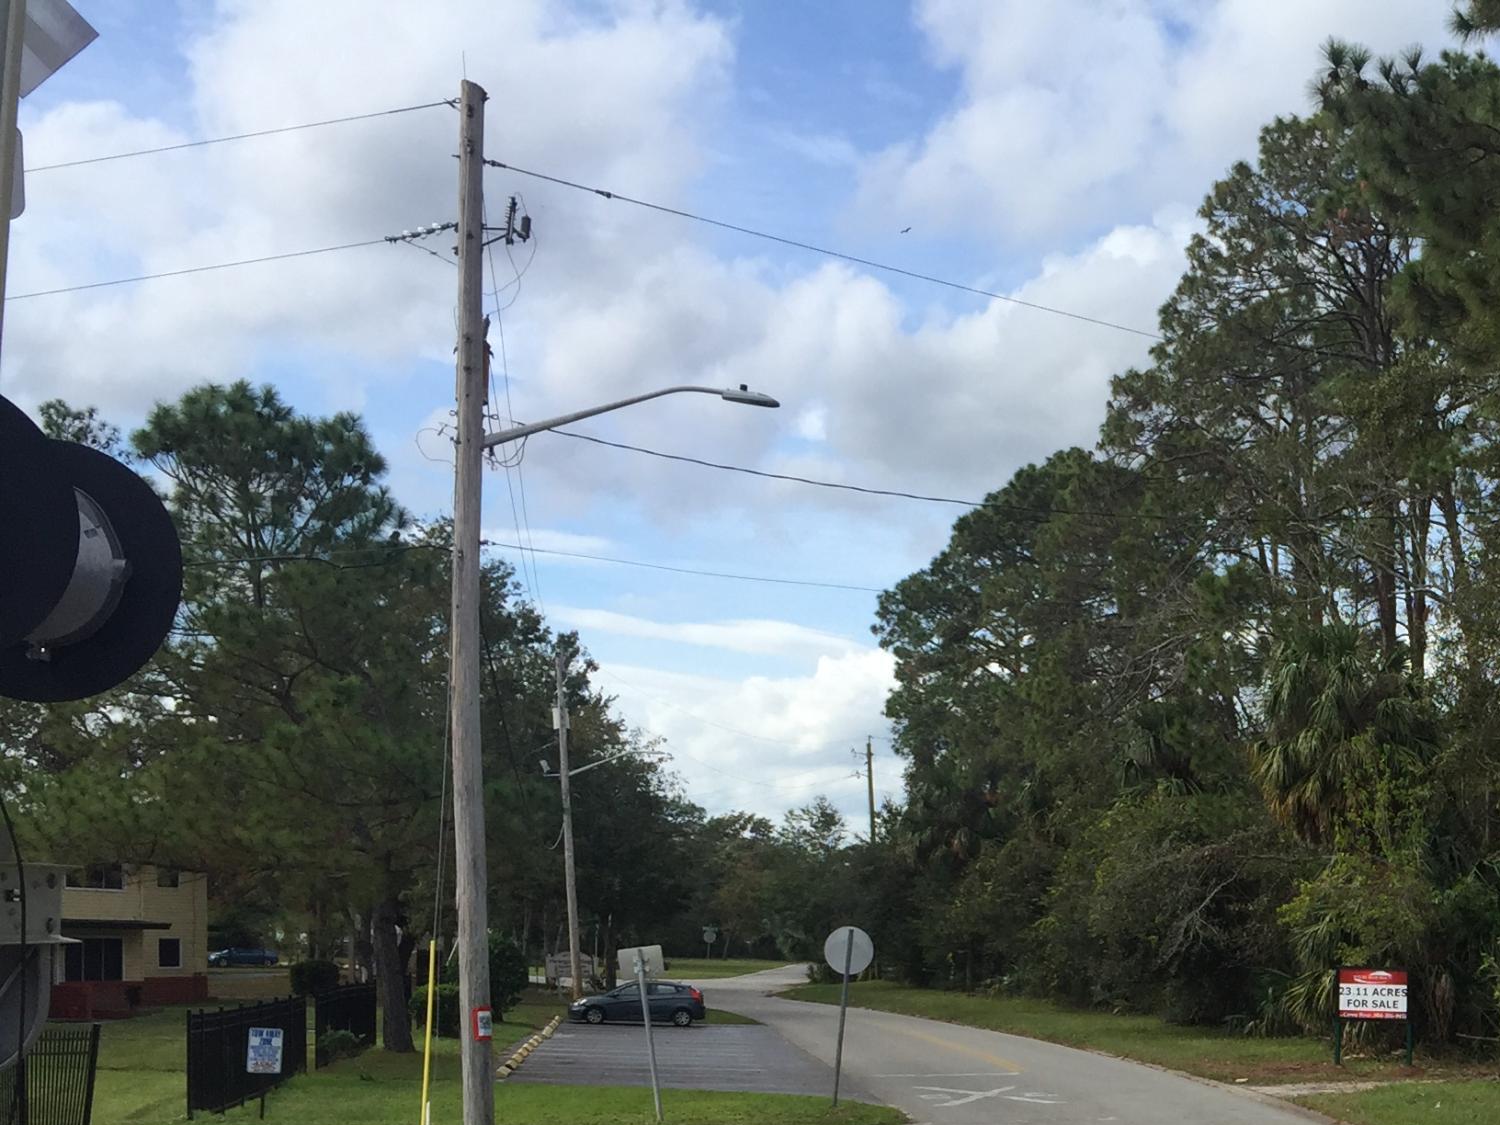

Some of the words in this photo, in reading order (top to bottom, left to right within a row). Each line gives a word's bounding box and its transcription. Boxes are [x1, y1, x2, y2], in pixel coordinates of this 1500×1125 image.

[1371, 987, 1408, 998] ACRES
[1346, 998, 1369, 1009] FOR
[1371, 999, 1400, 1009] SALE
